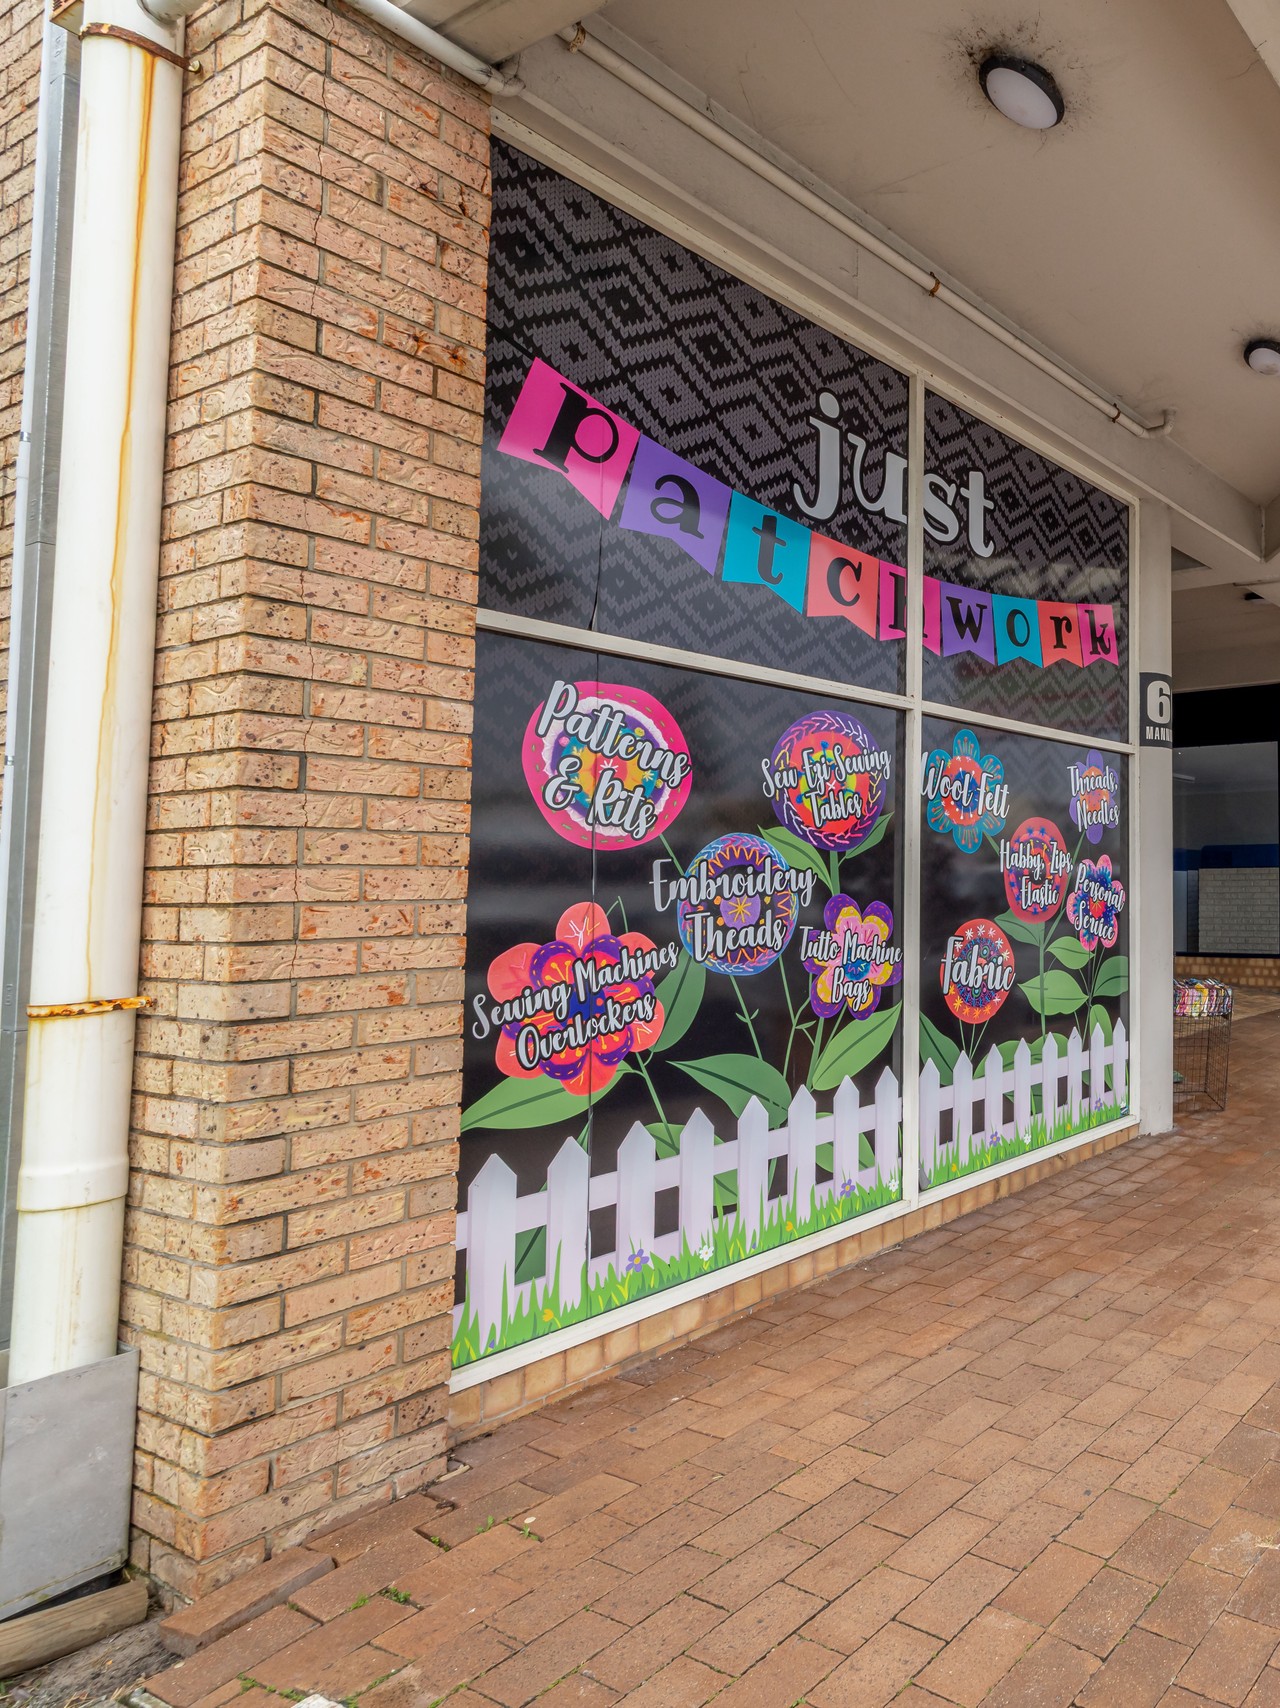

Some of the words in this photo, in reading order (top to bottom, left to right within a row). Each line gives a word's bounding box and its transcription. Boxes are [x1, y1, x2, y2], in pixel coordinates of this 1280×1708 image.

[792, 391, 995, 558] just
[1147, 680, 1171, 724] 6
[538, 680, 690, 788] Patterns
[544, 756, 580, 809] &
[588, 770, 658, 839] Kits
[761, 759, 798, 798] Sew
[834, 745, 891, 782] Sewing
[920, 751, 974, 807] Wool
[976, 772, 1010, 819] Felt
[1067, 764, 1118, 796] Threads,
[805, 790, 863, 828] Tables
[1076, 800, 1120, 832] Needles
[649, 857, 818, 911] Embroidery
[999, 839, 1045, 879] Habby,
[1050, 841, 1074, 875] Zips,
[1020, 876, 1059, 910] Elastic
[1075, 862, 1125, 913] Personal
[685, 910, 788, 963] Theads
[799, 926, 840, 963] Tutto
[841, 933, 902, 966] Machine
[1074, 901, 1115, 940] Service
[472, 979, 571, 1039] Sewing
[574, 942, 679, 1002] Machines
[832, 969, 872, 1010] Bags
[941, 935, 1016, 995] Fabric
[517, 994, 656, 1069] Overlockers
